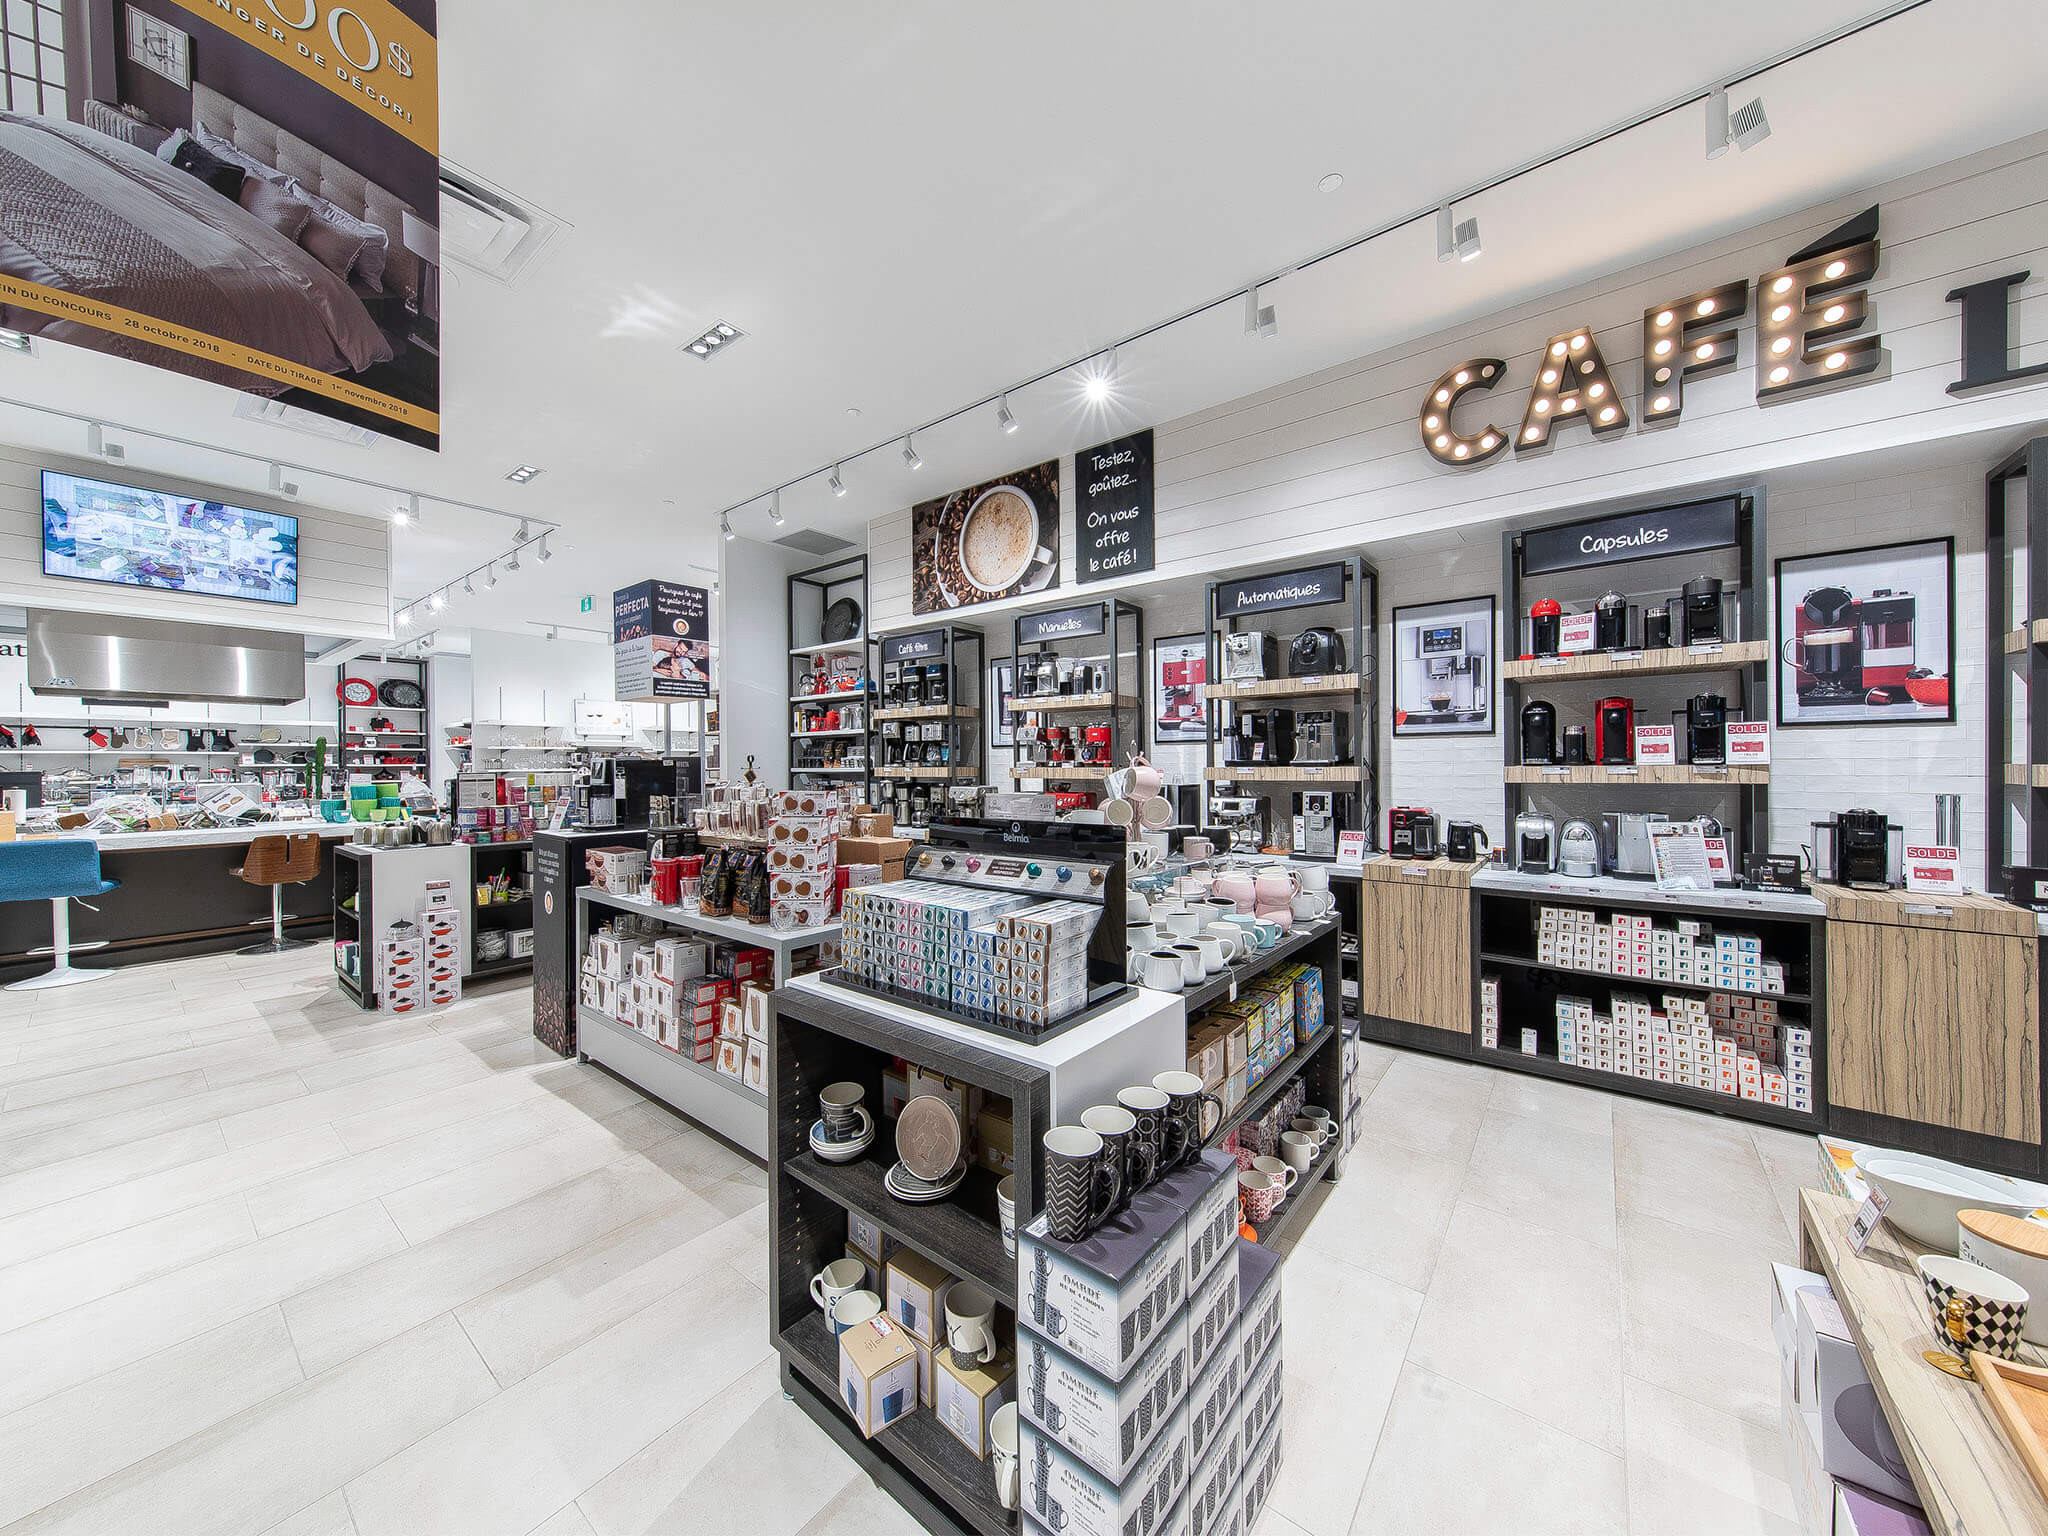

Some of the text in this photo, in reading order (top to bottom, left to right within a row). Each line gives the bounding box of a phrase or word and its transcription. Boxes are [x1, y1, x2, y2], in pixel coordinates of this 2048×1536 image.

[207, 0, 413, 124] NGER DE DÉCOR!
[1419, 203, 1882, 467] CAFÉ
[21, 289, 39, 301] DU
[43, 295, 112, 321] CONCOURS
[125, 317, 140, 329] 28
[143, 324, 189, 344] octobre
[192, 338, 220, 353] 2018
[247, 356, 273, 370] DATE
[274, 365, 288, 375] DU
[289, 369, 323, 386] TIRAGE
[344, 388, 387, 409] novembre
[388, 403, 408, 416] 2018
[1091, 450, 1135, 471] Testez,
[1088, 473, 1137, 497] goûtez...
[1087, 505, 1140, 528] On vous
[1095, 529, 1130, 549] offre
[1580, 527, 1669, 554] Capsules
[1089, 558, 1100, 573] le
[1237, 583, 1321, 609] Automatiques
[615, 596, 650, 618] PERFECTA
[1038, 618, 1082, 634] Manuelles
[898, 642, 913, 655] Café
[1637, 727, 1672, 736] SOLDE
[1728, 724, 1767, 734] SOLDE
[1341, 832, 1364, 840] SOLDE
[1908, 848, 1957, 859] SOLDE
